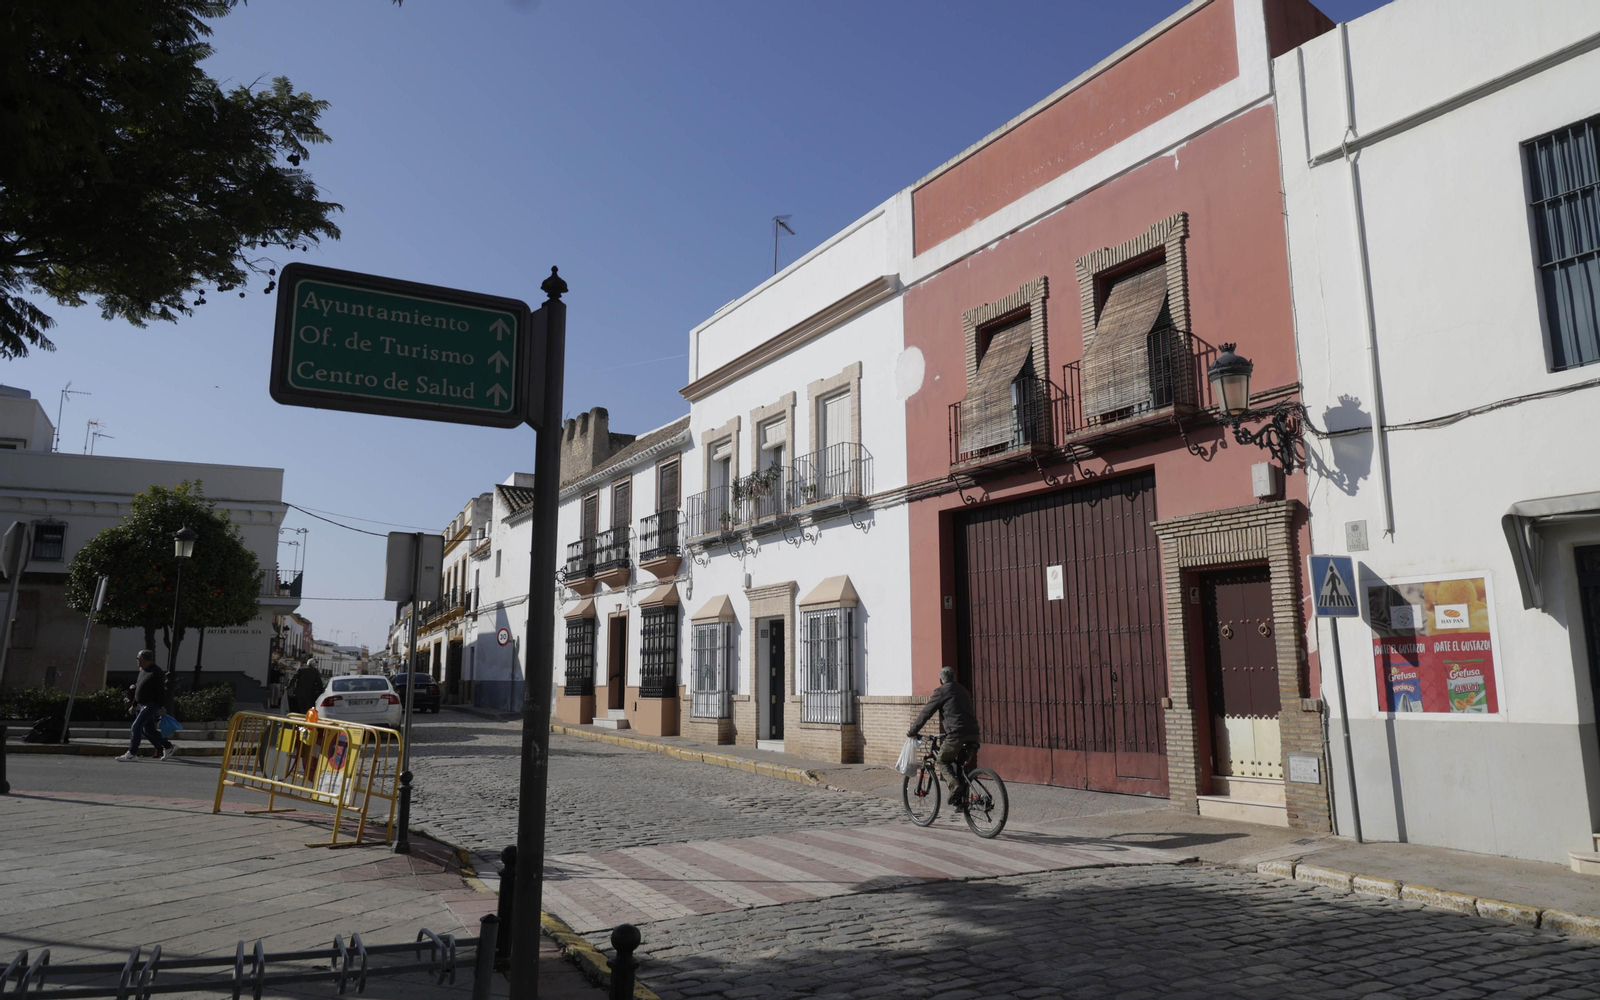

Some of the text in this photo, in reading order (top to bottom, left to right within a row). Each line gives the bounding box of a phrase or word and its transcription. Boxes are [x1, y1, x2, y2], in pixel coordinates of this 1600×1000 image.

[301, 291, 470, 332] Ayuntamiento
[299, 326, 475, 365] Of. de Turismo
[296, 361, 475, 400] Centro de Salud
[1391, 644, 1398, 654] EL
[1434, 640, 1491, 653] ¡DATE EL GUSTAZO!
[1388, 671, 1416, 682] Grefusa
[1449, 669, 1480, 679] Grefusa
